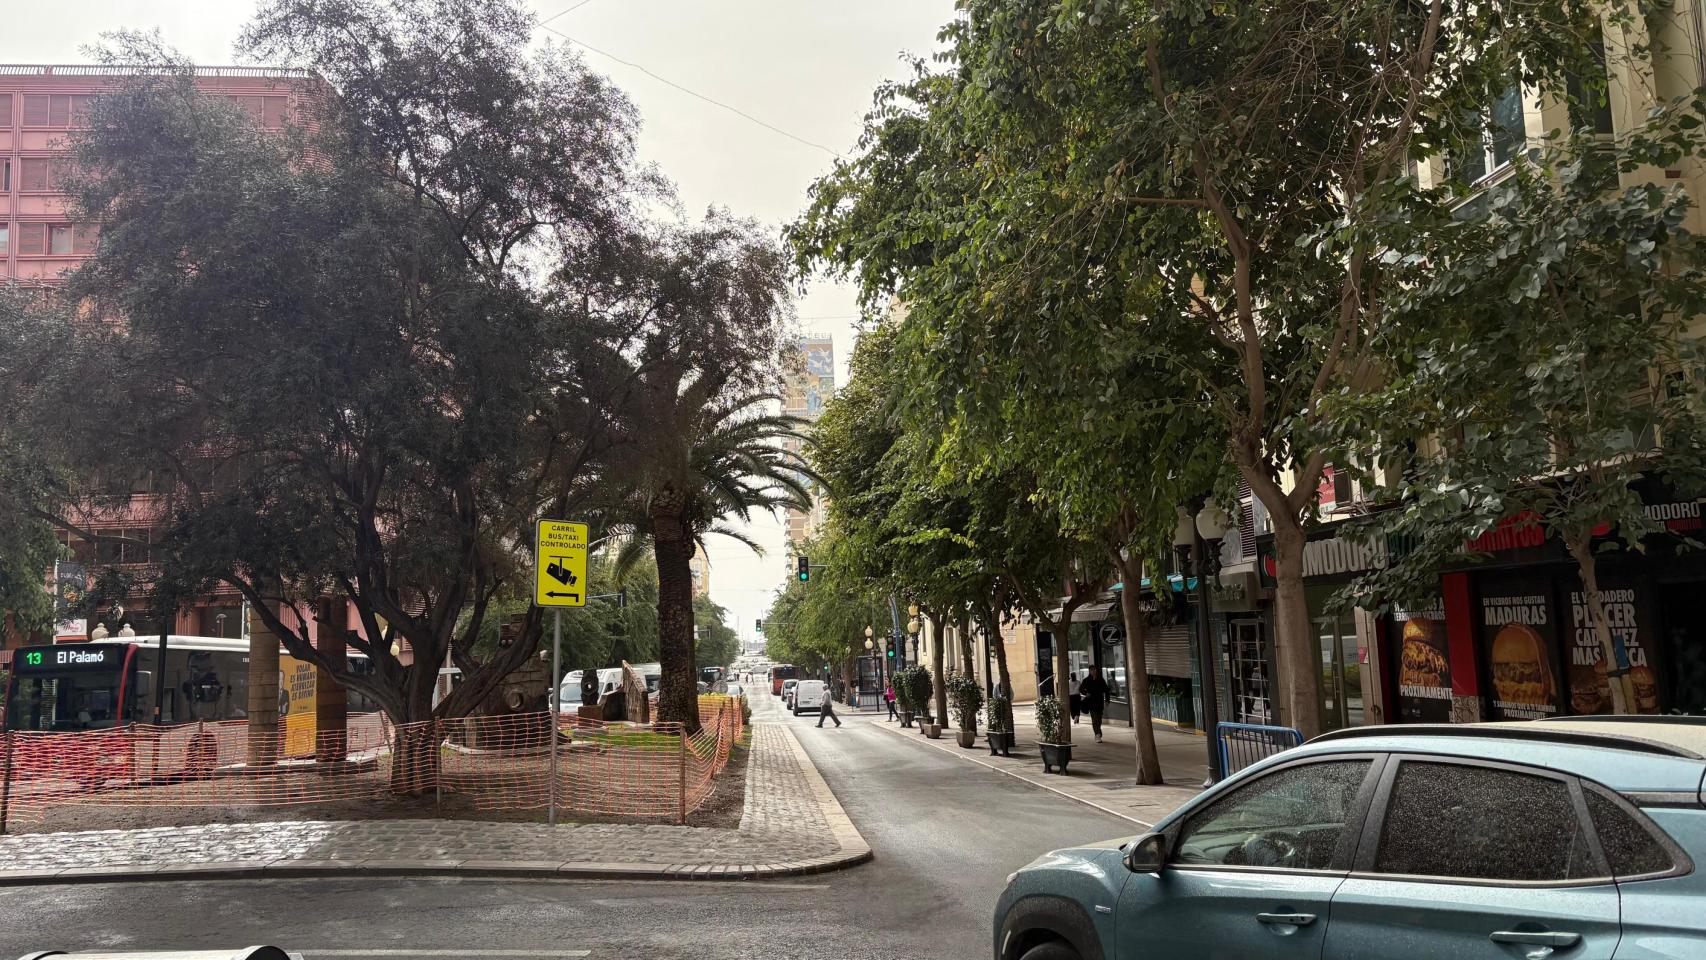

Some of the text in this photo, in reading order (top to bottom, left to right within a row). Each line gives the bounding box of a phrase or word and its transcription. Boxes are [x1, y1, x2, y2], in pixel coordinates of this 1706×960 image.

[540, 540, 586, 549] CONTROLADO
[548, 533, 579, 541] BUS/TAXI
[1512, 596, 1523, 605] NOS
[1524, 595, 1545, 605] GUSTAN
[1571, 588, 1635, 604] EL VDADERO
[1484, 605, 1547, 626] MADURAS
[1572, 603, 1637, 628] PLCER
[1575, 628, 1600, 647] CAD
[26, 650, 104, 665] 13 El Palamó
